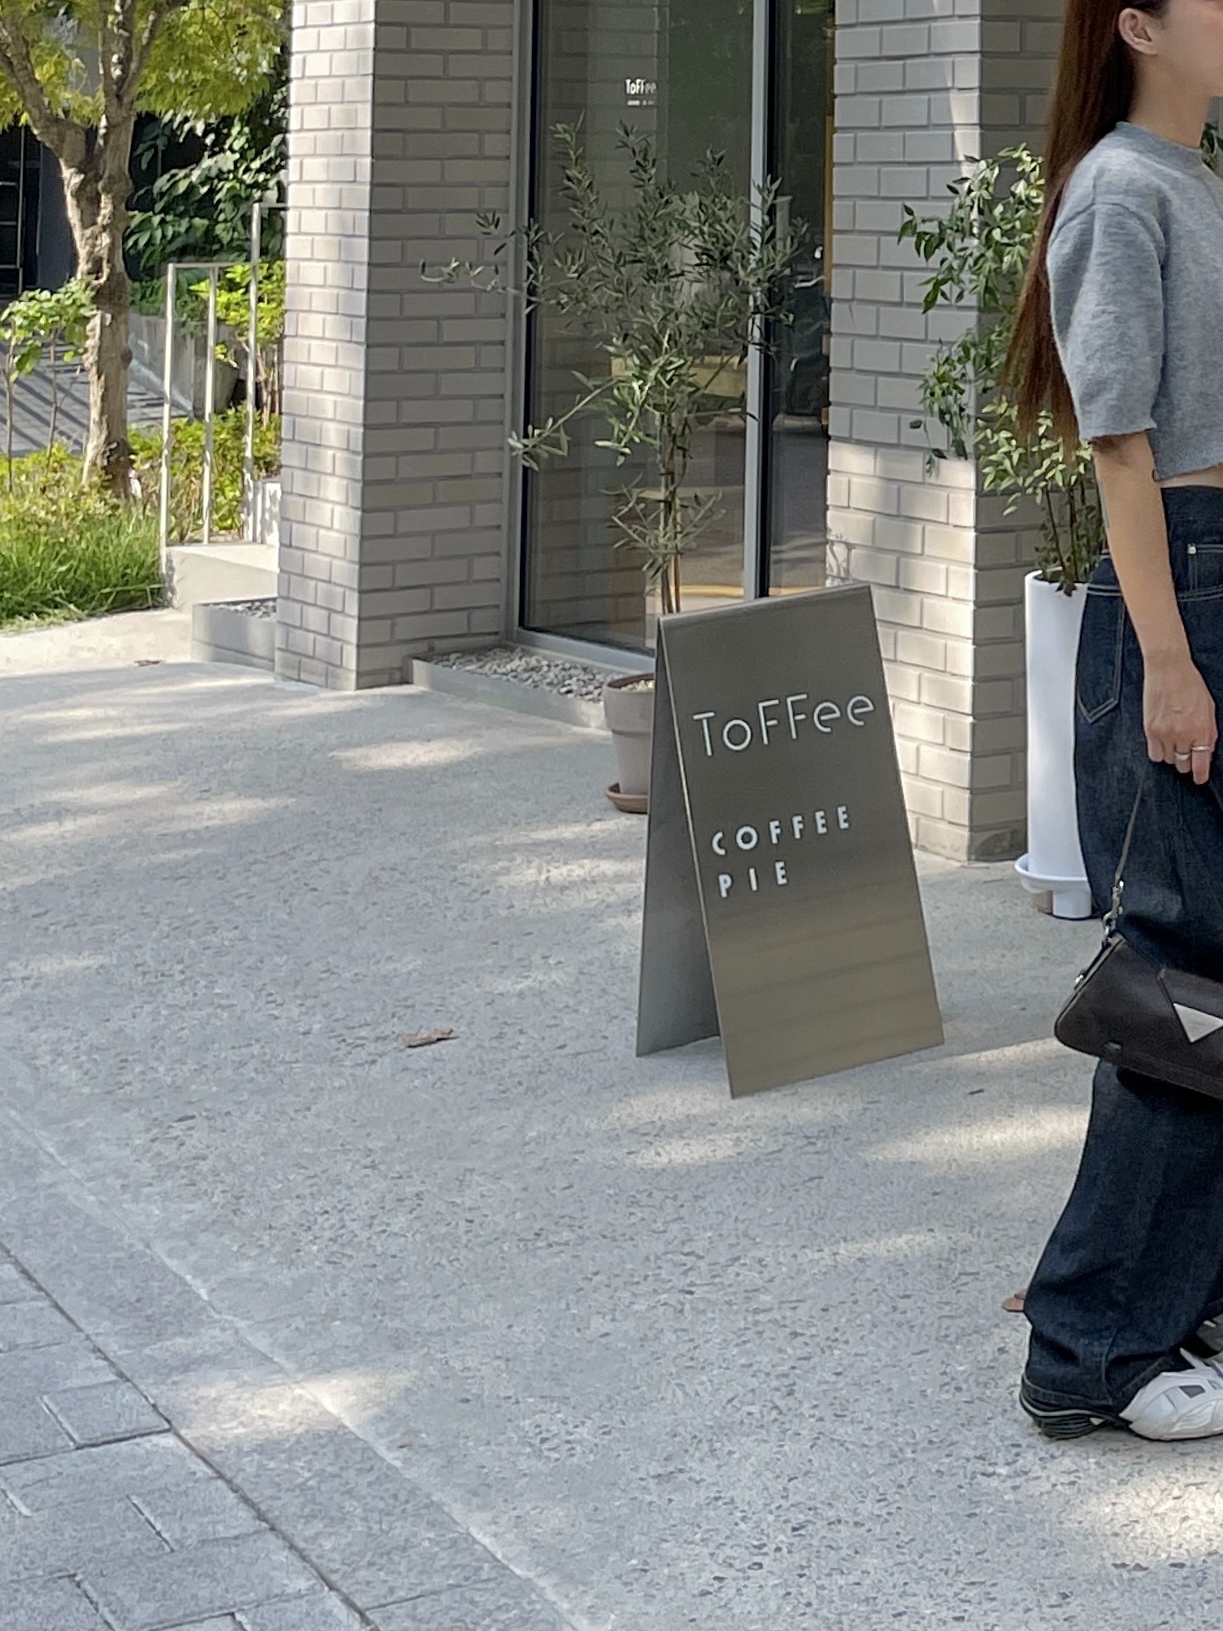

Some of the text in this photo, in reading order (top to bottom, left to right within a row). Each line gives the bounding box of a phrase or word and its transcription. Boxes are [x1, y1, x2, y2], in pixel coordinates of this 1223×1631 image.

[693, 693, 875, 757] ToFFee
[711, 805, 850, 856] COFFEE
[718, 861, 788, 898] PIE
